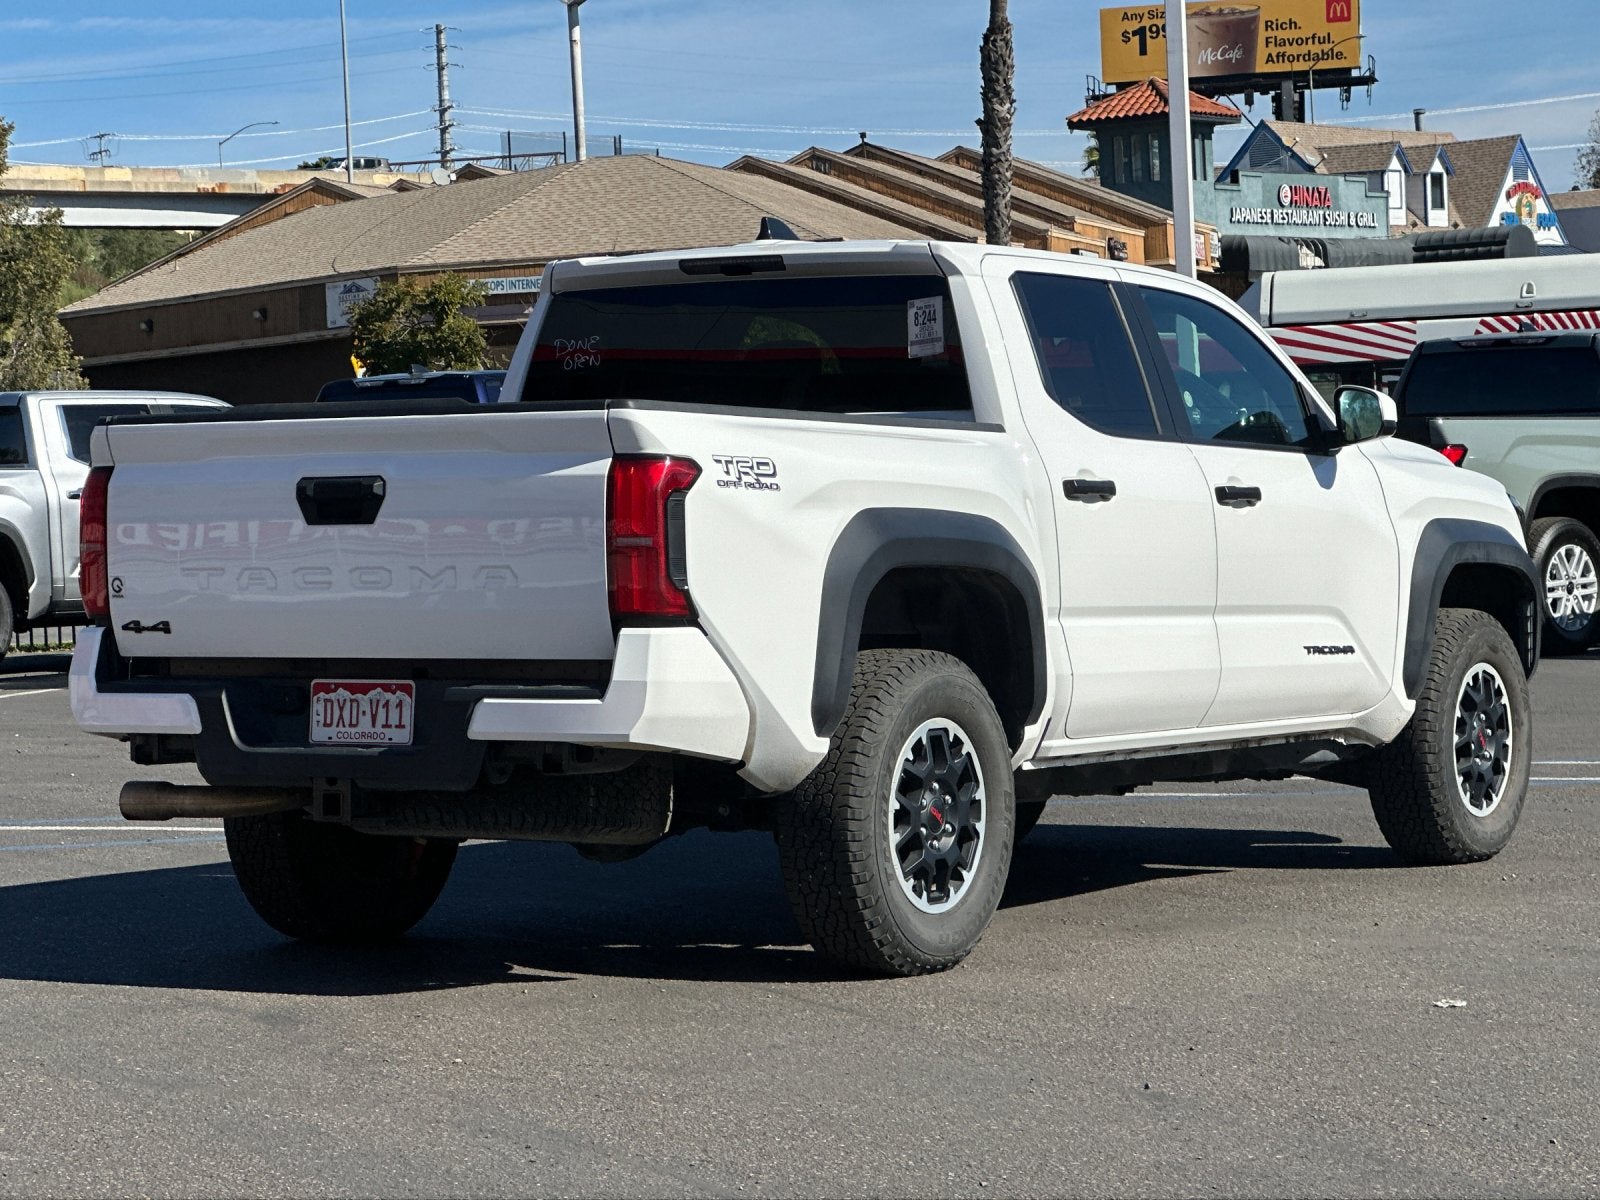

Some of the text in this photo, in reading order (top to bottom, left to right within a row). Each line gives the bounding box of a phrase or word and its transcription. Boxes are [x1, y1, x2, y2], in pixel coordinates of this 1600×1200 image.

[1121, 9, 1167, 23] Any Siz
[1264, 18, 1302, 32] Rich.
[1265, 32, 1335, 48] Flavorful.
[1265, 48, 1347, 65] Affordable.
[1291, 184, 1333, 208] HINATA
[1230, 206, 1378, 228] JAPANESE RESTAURANT SUSHI & GRILL
[508, 278, 541, 290] INTERNE
[913, 308, 937, 327] 8:244
[553, 335, 600, 360] DONE
[563, 353, 601, 370] OPEN
[712, 454, 778, 482] TRD
[716, 480, 781, 492] OFF ROAD
[179, 564, 519, 591] TACOMA
[336, 731, 386, 741] COLORADO
